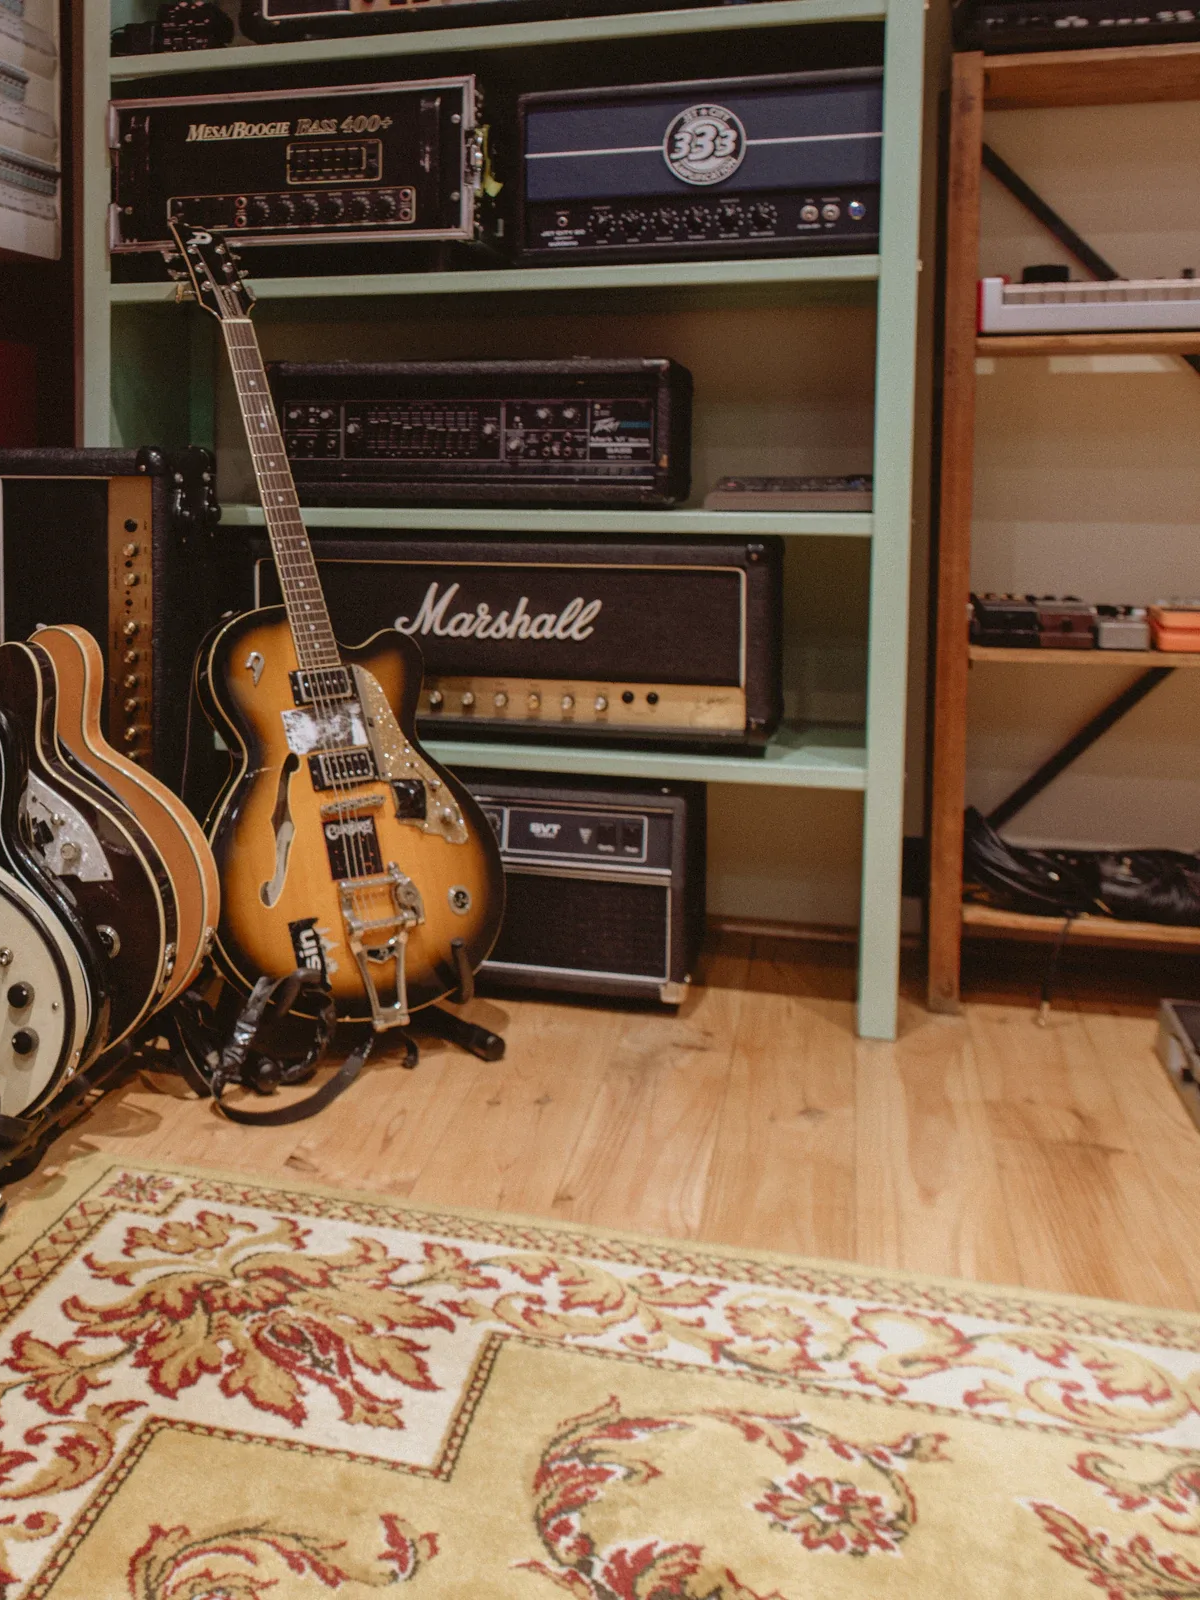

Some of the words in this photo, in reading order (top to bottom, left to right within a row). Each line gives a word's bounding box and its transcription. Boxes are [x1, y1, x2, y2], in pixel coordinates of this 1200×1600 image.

[185, 121, 291, 142] MESA/BOOGIE
[295, 118, 338, 137] BASS
[669, 124, 737, 161] 333
[393, 581, 604, 642] Marshall
